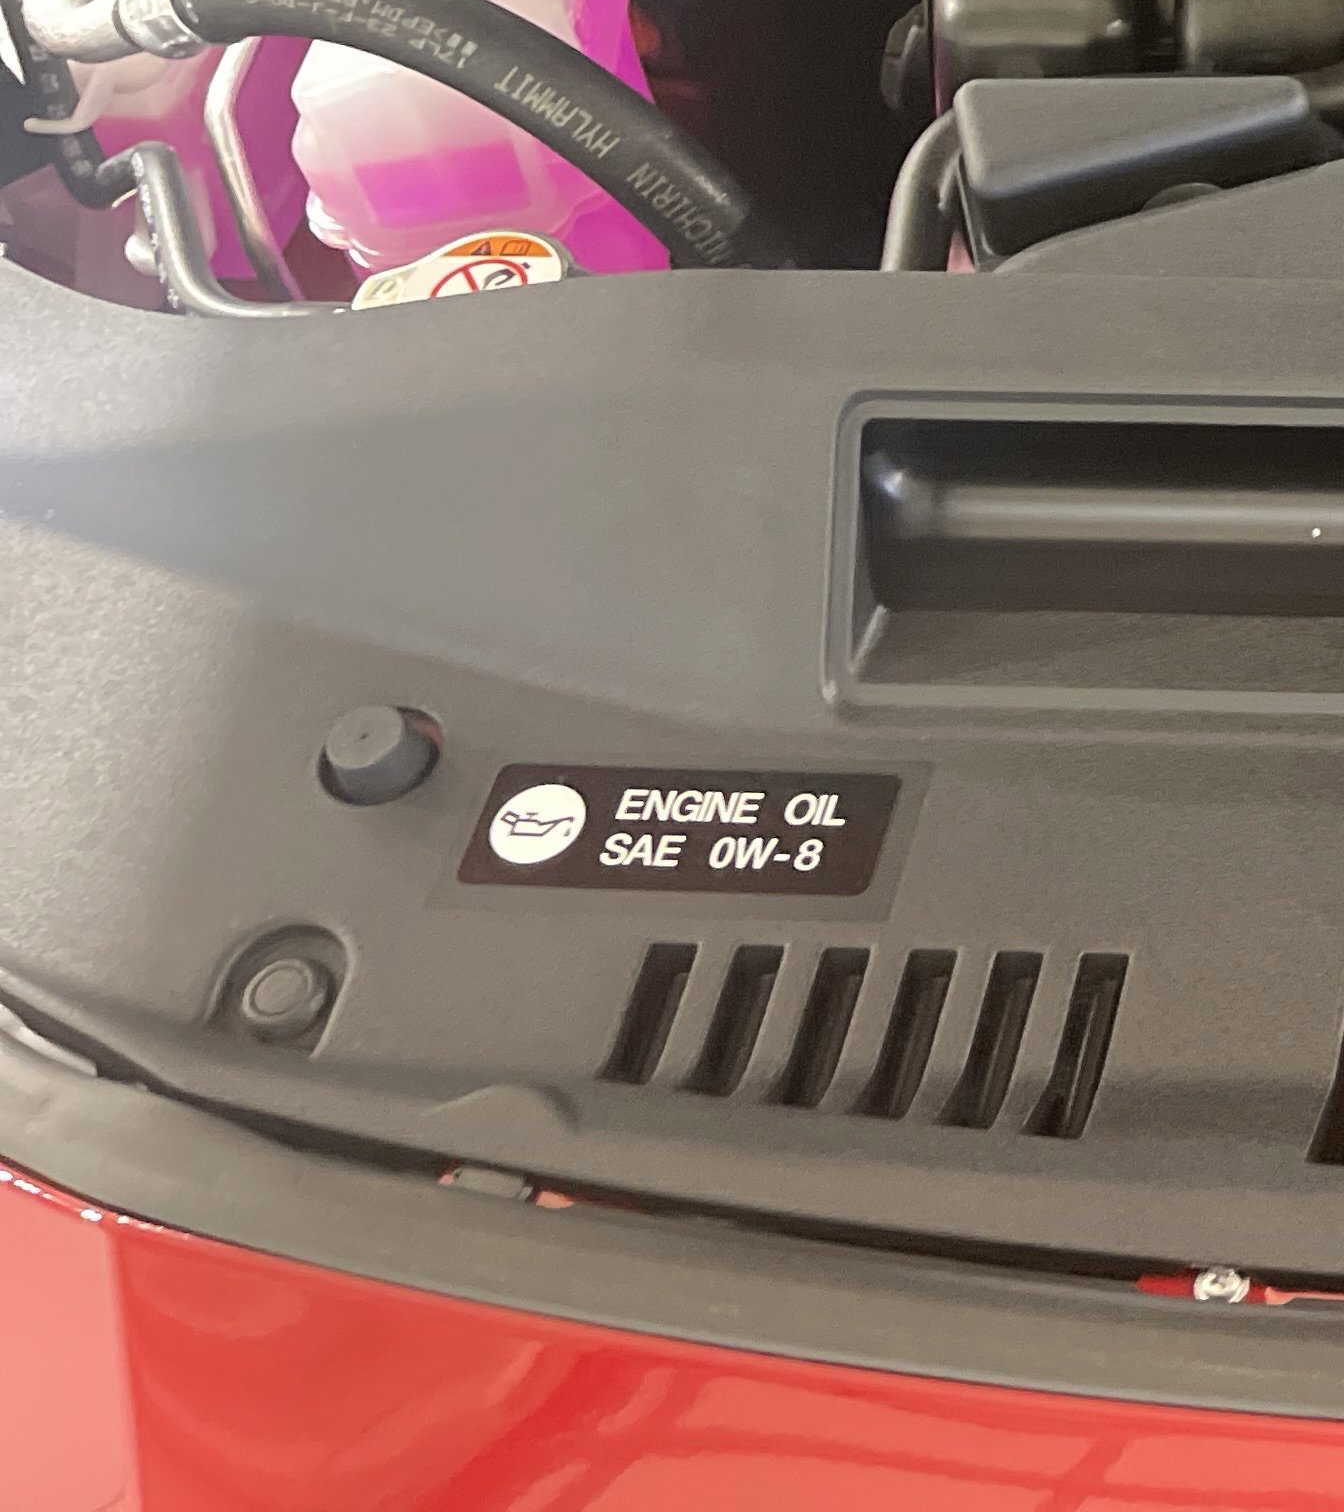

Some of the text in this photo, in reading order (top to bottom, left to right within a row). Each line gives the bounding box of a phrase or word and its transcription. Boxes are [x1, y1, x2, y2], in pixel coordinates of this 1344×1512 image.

[615, 788, 846, 827] ENGINE OIL
[599, 832, 825, 872] SAE 0W-8
